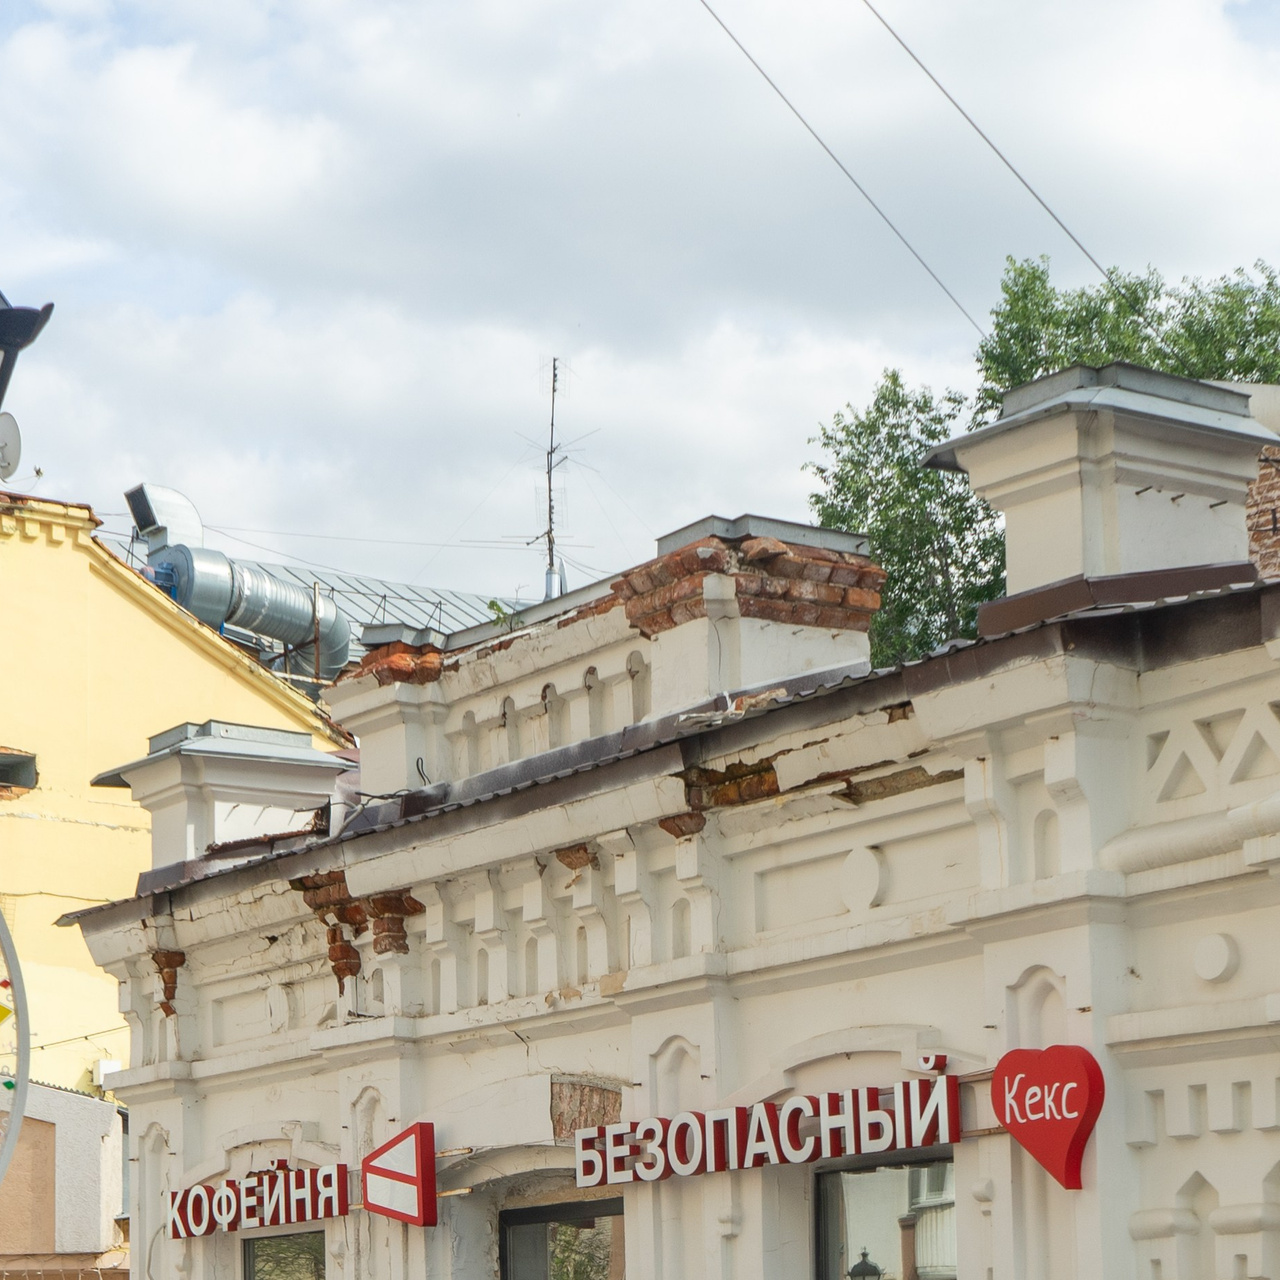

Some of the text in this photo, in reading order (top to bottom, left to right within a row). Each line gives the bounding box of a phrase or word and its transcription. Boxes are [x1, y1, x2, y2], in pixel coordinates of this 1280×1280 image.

[575, 1054, 960, 1189] БЕЗОПАСНЫЙ
[1004, 1073, 1078, 1124] Кекс
[168, 1159, 349, 1240] КОФЕЙНЯ
